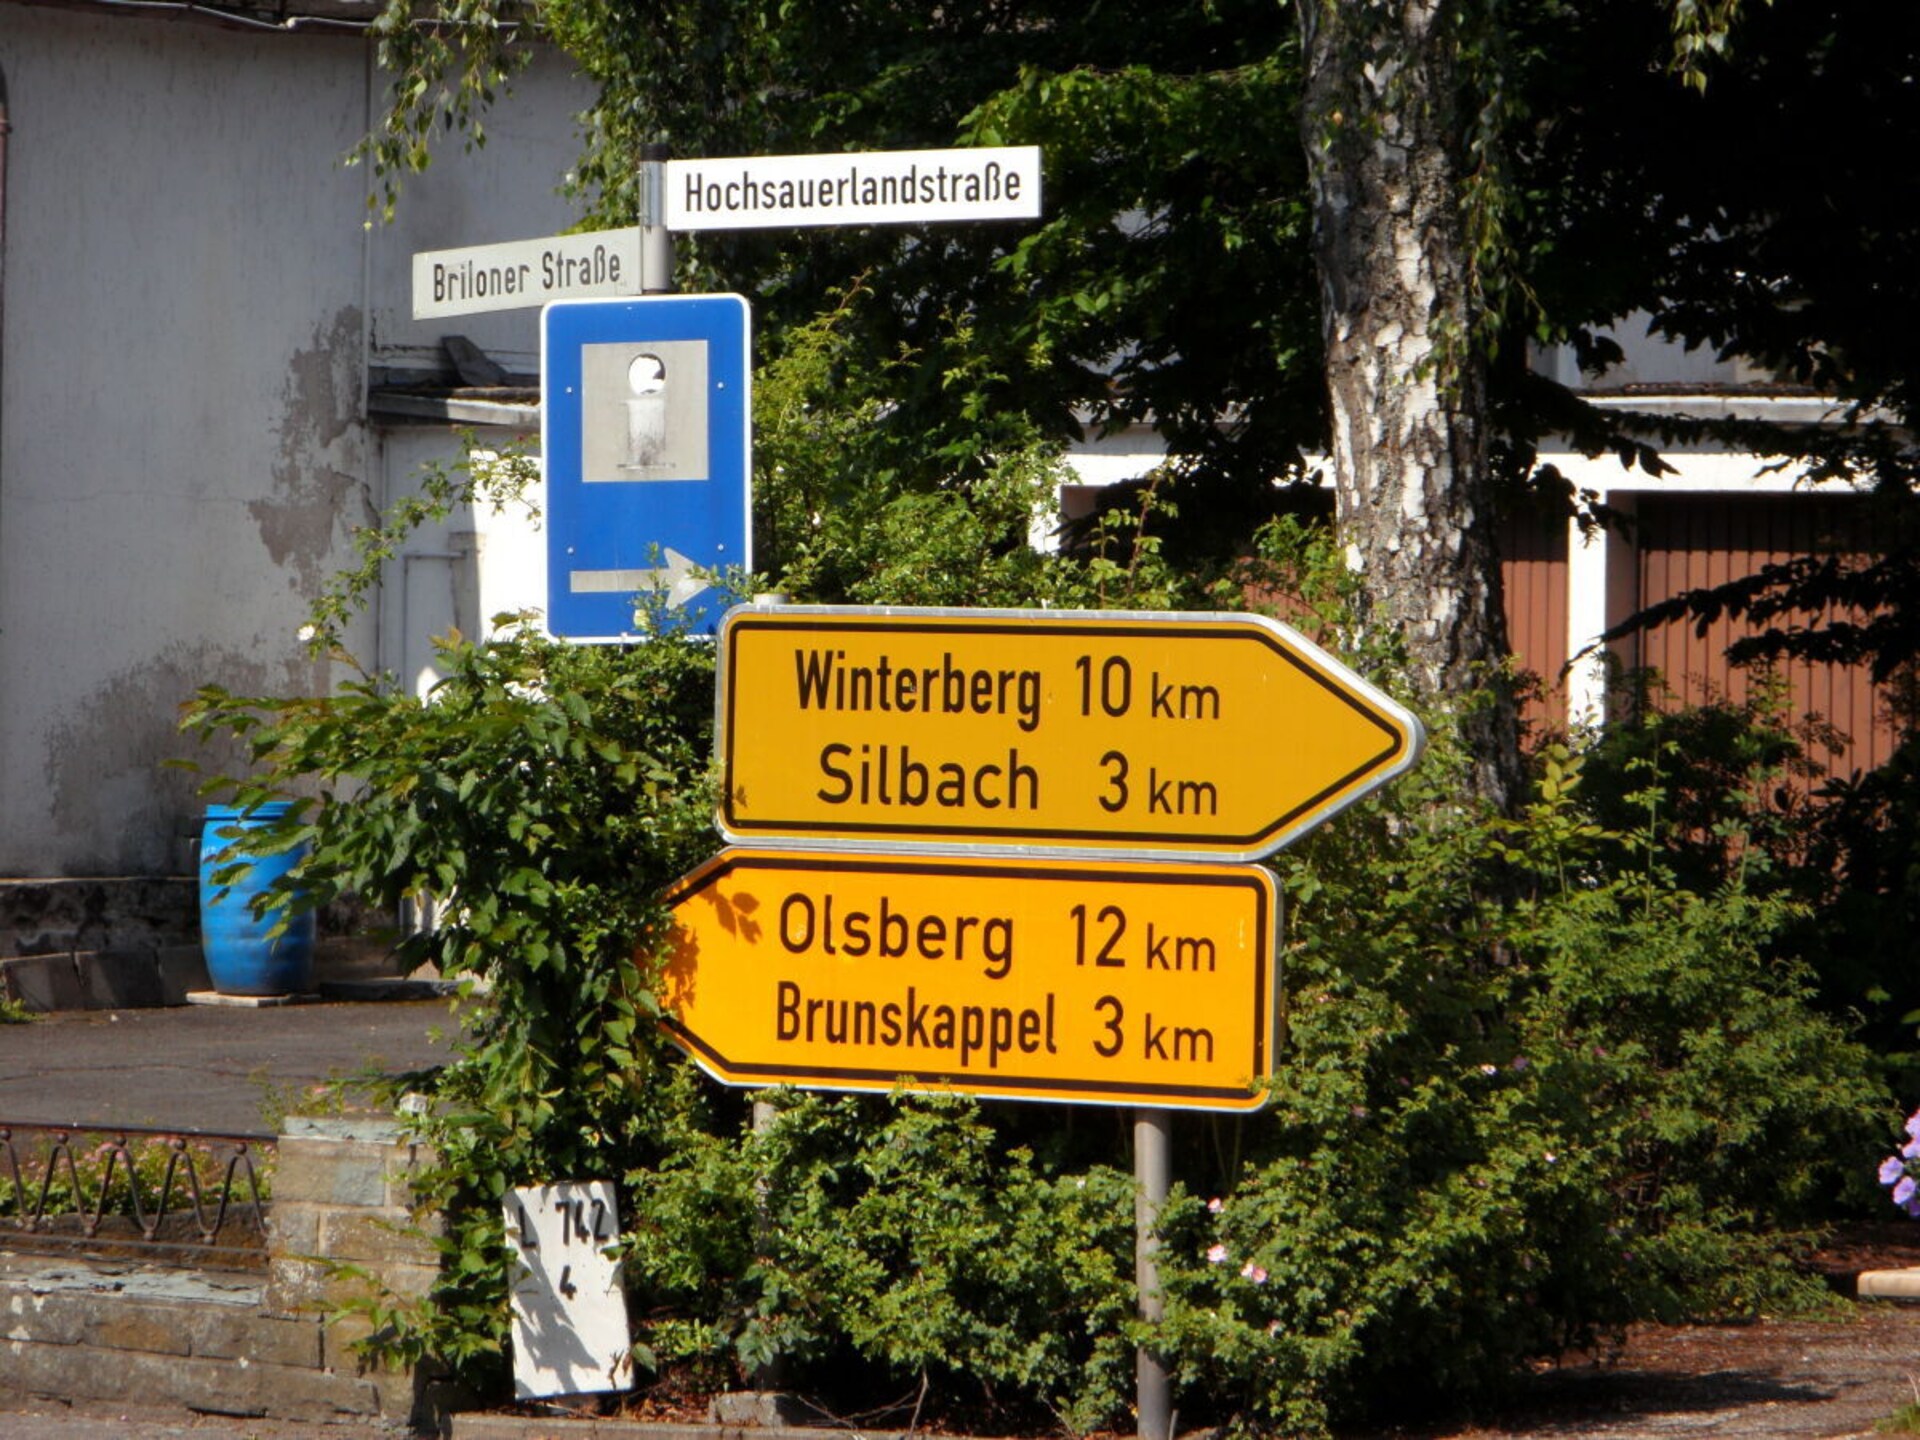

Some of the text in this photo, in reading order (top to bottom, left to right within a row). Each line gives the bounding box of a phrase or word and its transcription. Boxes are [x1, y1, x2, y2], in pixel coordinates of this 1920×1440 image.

[686, 162, 1020, 212] Hochsauerlandstraße
[433, 244, 621, 302] Briloner Straße
[795, 650, 1220, 733] Winterberg 10 km
[817, 743, 1217, 815] Silbach 3 km
[779, 892, 1216, 979] Olsberg 12 km
[776, 981, 1214, 1068] Brunskappel 3 km
